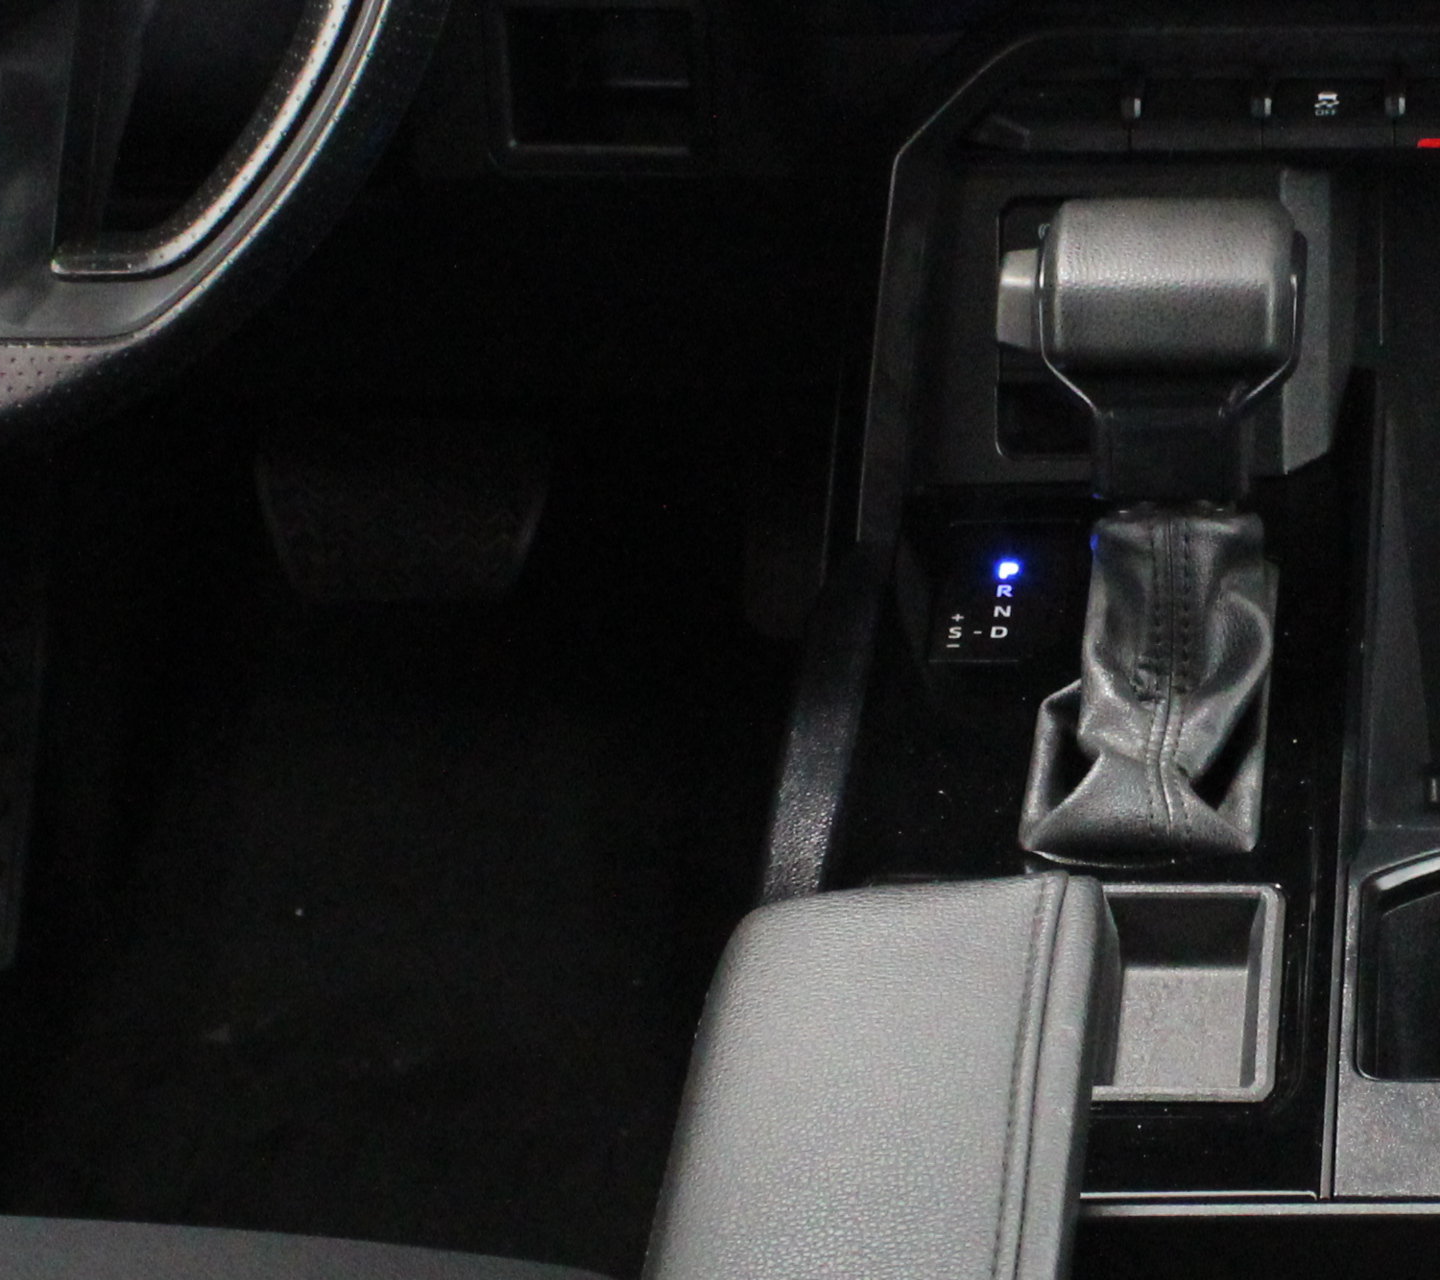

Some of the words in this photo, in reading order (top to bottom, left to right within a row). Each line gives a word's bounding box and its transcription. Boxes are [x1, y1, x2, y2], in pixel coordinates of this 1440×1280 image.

[998, 561, 1020, 580] P
[996, 584, 1014, 598] R
[993, 605, 1012, 618] N
[947, 626, 963, 639] S
[989, 626, 1009, 639] D
